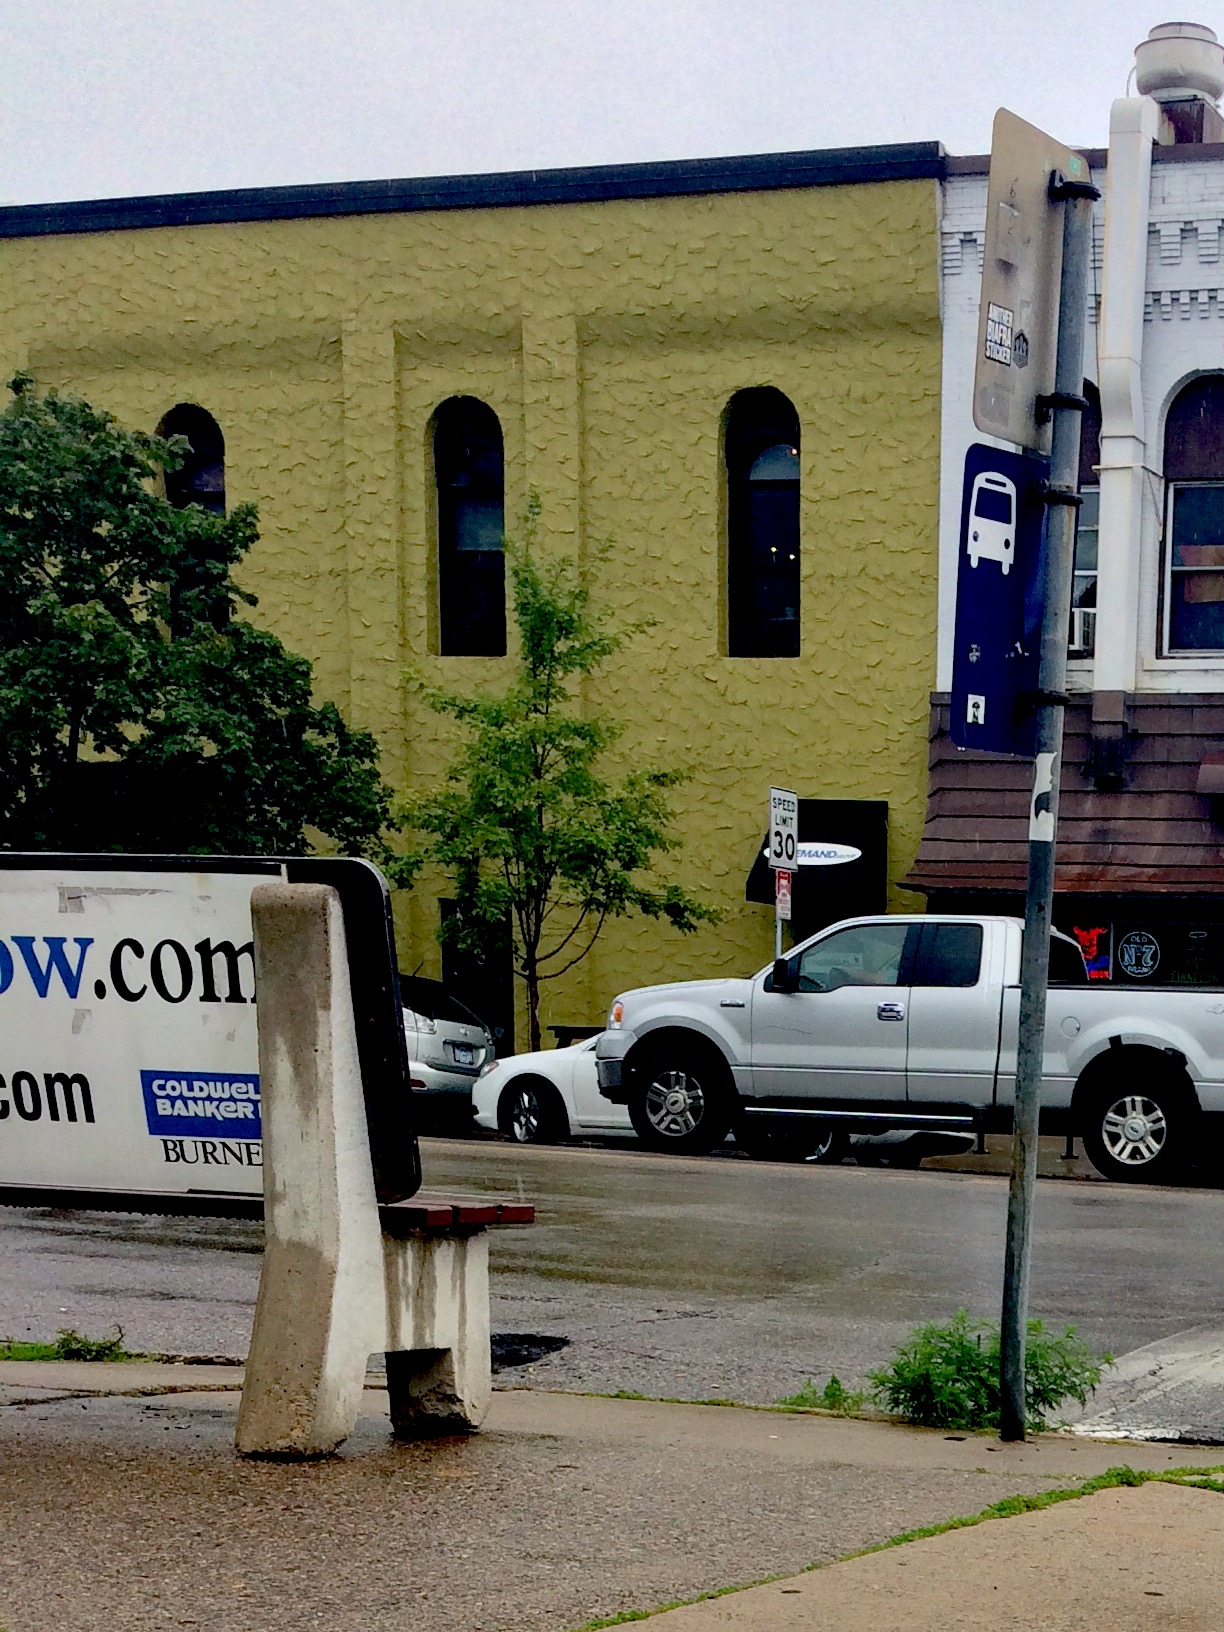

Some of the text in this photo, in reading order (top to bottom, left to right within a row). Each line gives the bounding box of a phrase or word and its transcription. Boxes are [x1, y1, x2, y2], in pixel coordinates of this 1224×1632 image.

[772, 797, 796, 813] SPEED
[774, 813, 794, 829] LIMIT
[773, 830, 796, 861] 30
[796, 850, 837, 859] EMAND
[1130, 935, 1149, 944] OLD
[151, 1079, 262, 1101] COLDWEL
[155, 1098, 256, 1121] BANKER
[159, 1138, 263, 1167] BURNE
